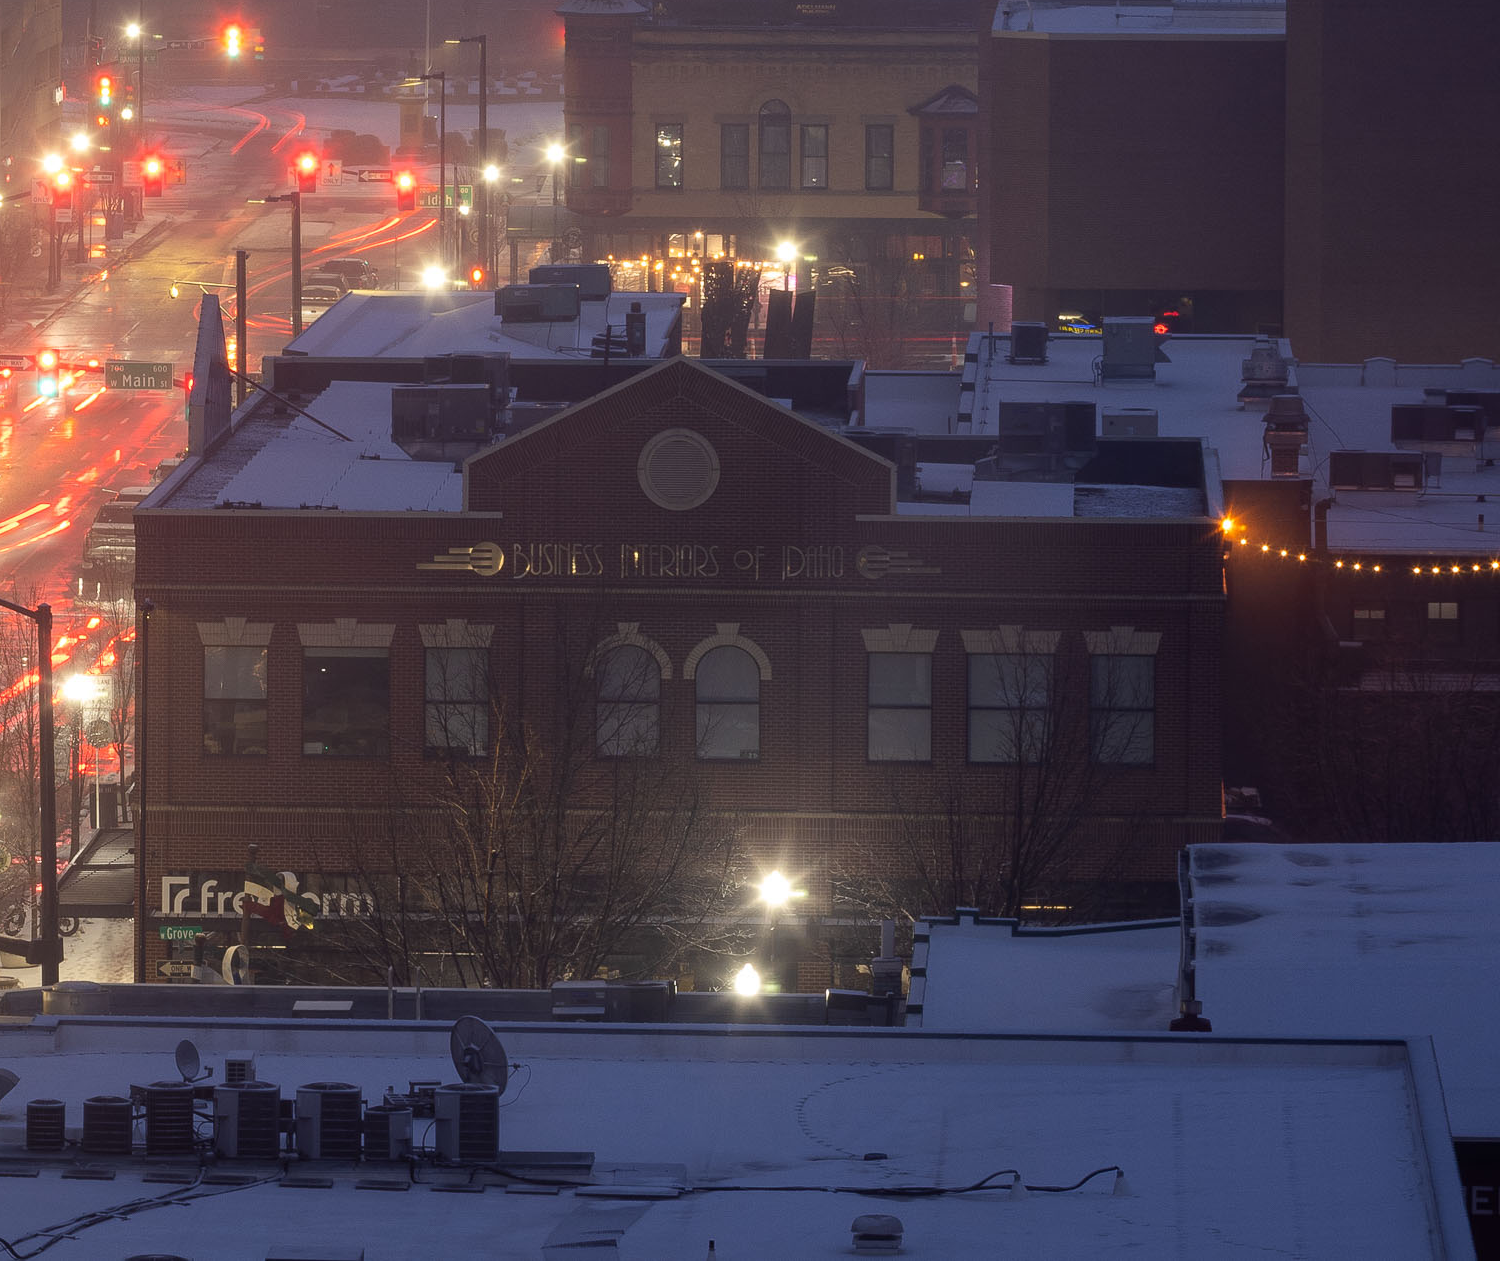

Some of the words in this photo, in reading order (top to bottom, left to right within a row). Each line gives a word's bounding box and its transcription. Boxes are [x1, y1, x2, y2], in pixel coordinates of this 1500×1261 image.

[10, 359, 23, 367] WAY
[110, 364, 124, 372] 700
[152, 364, 167, 372] 600
[122, 374, 156, 388] Main
[160, 380, 168, 388] St
[513, 543, 605, 579] BUSINESS
[620, 544, 720, 579] INTERIORS
[733, 545, 765, 581] OF
[782, 545, 844, 581] IDAHO
[166, 927, 194, 940] Grove
